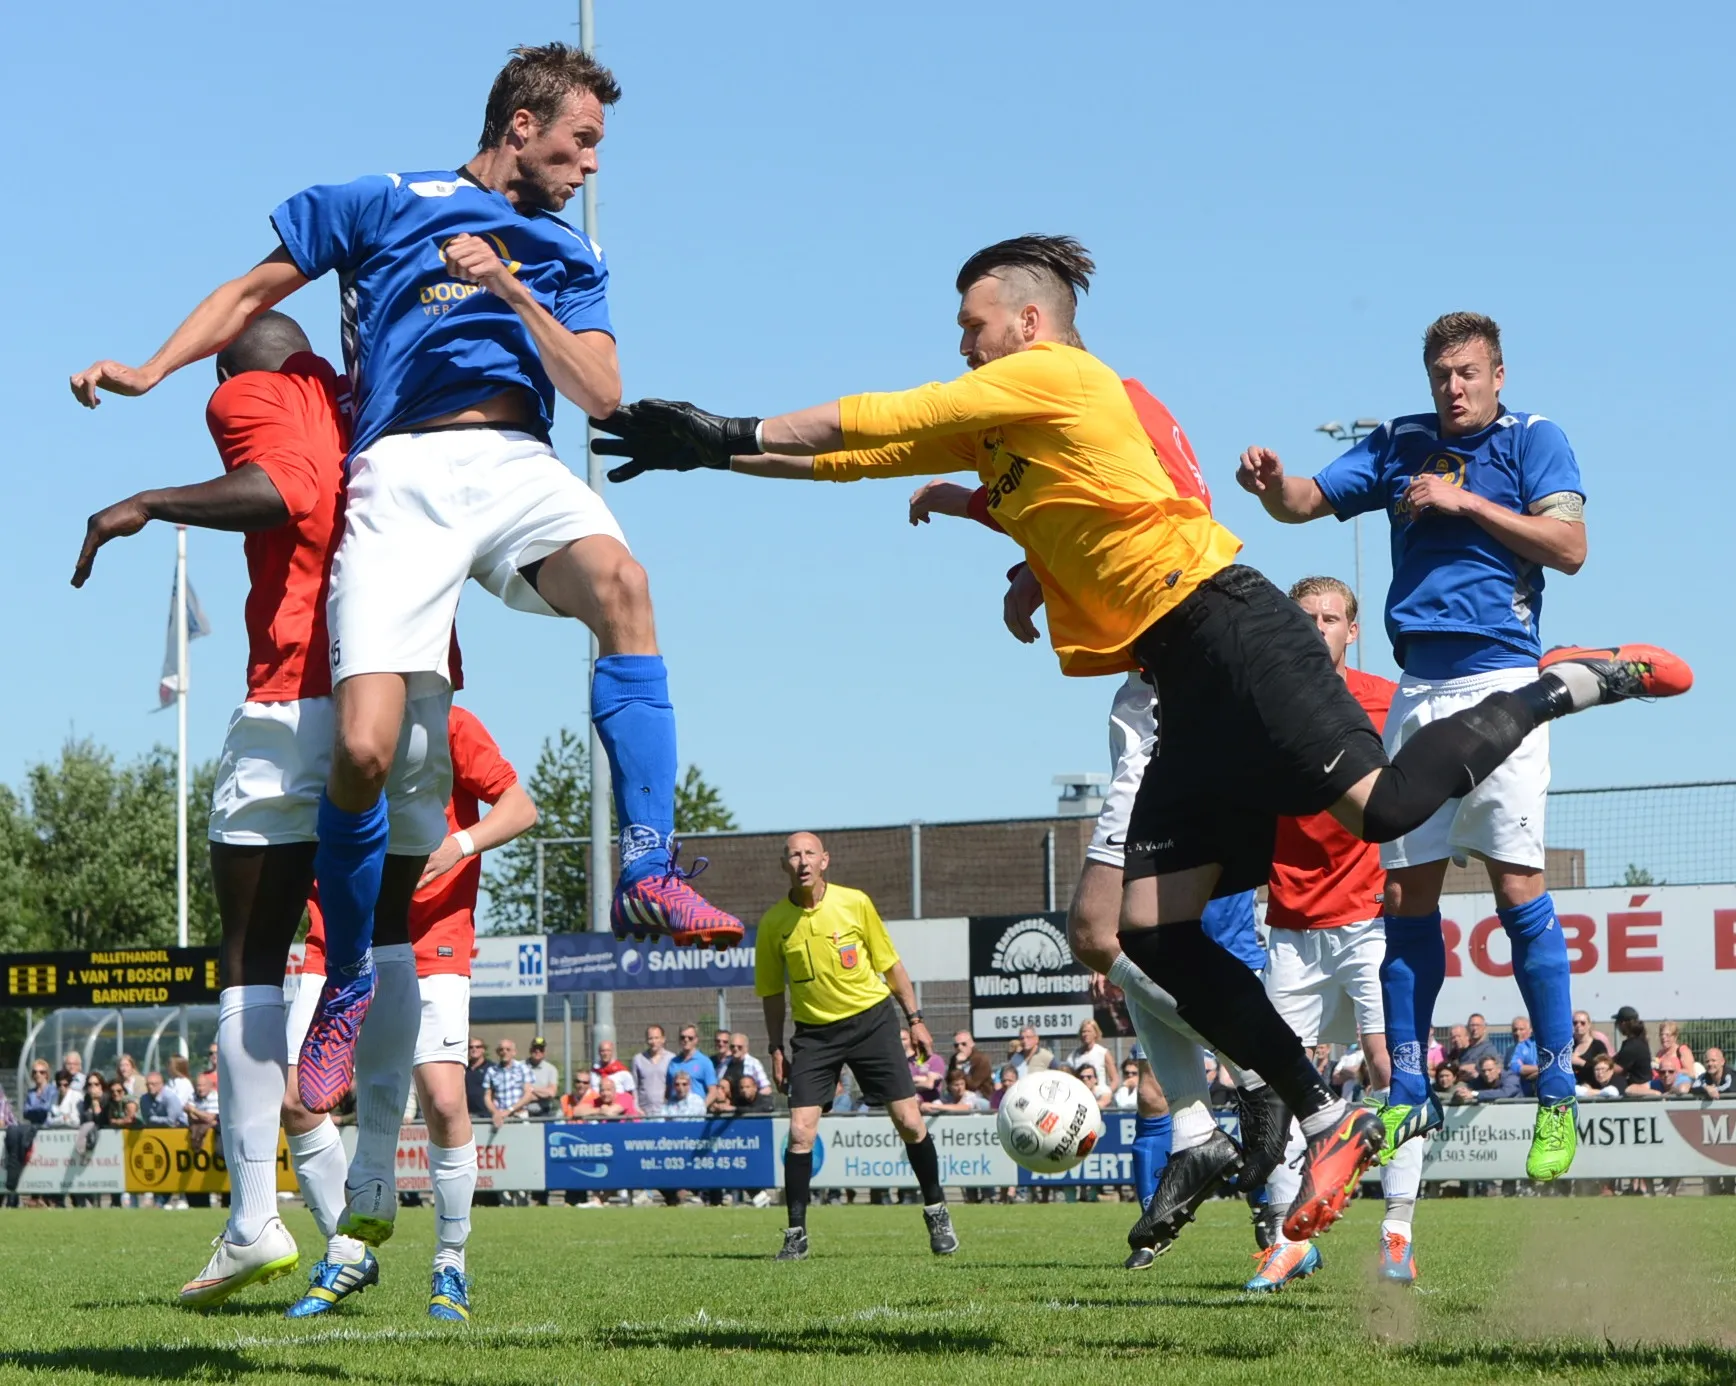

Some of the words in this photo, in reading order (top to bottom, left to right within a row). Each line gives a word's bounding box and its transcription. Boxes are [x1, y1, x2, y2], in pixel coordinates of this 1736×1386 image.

[91, 951, 169, 964] PALLETHANDEL
[67, 971, 77, 985] J.
[80, 969, 108, 984] VAN
[127, 968, 171, 983] BOSCH
[175, 966, 194, 981] BV
[519, 978, 543, 986] NVM
[974, 976, 1019, 996] Wilco
[92, 988, 168, 1004] BARNEVELD
[995, 1016, 1008, 1029] 06
[1012, 1016, 1024, 1028] 54
[1028, 1015, 1041, 1027] 68
[1044, 1015, 1058, 1027] 68
[1061, 1014, 1073, 1026] 31
[831, 1129, 935, 1148] Autosch
[942, 1128, 1000, 1147] Herste
[1576, 1117, 1664, 1146] MSTEL
[550, 1147, 567, 1158] DE
[569, 1143, 613, 1158] VRIES
[624, 1136, 759, 1153] www.devriesnijkerk.nl
[664, 1157, 684, 1169] 033
[693, 1157, 714, 1170] 246
[716, 1157, 730, 1169] 45
[732, 1156, 747, 1169] 45
[1438, 1150, 1465, 1162] 1303
[1469, 1150, 1497, 1161] 5600
[937, 1154, 992, 1182] jkerk
